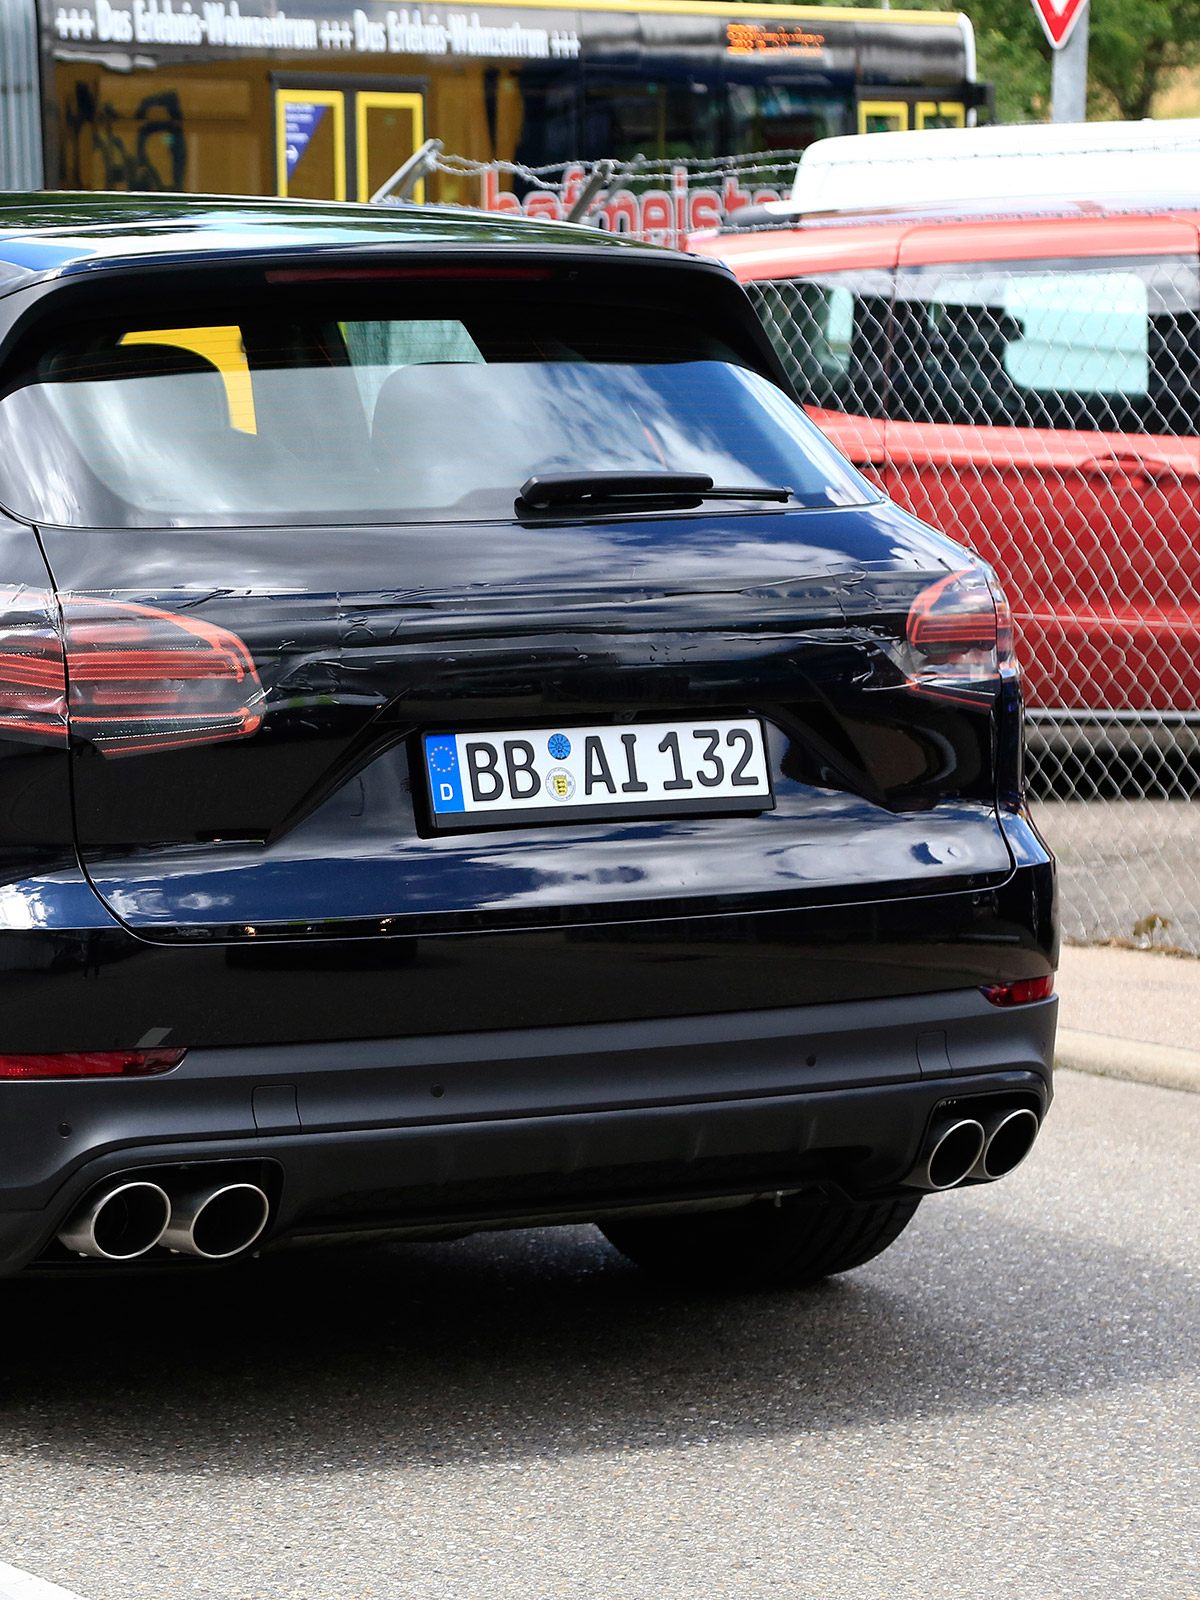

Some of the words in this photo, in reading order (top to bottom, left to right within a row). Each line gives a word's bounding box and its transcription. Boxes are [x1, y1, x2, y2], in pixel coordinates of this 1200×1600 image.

[353, 8, 387, 53] Das
[481, 164, 792, 250] hfmeist
[440, 783, 453, 801] D
[466, 740, 541, 802] BB
[585, 734, 648, 795] AI
[659, 728, 759, 791] 132
